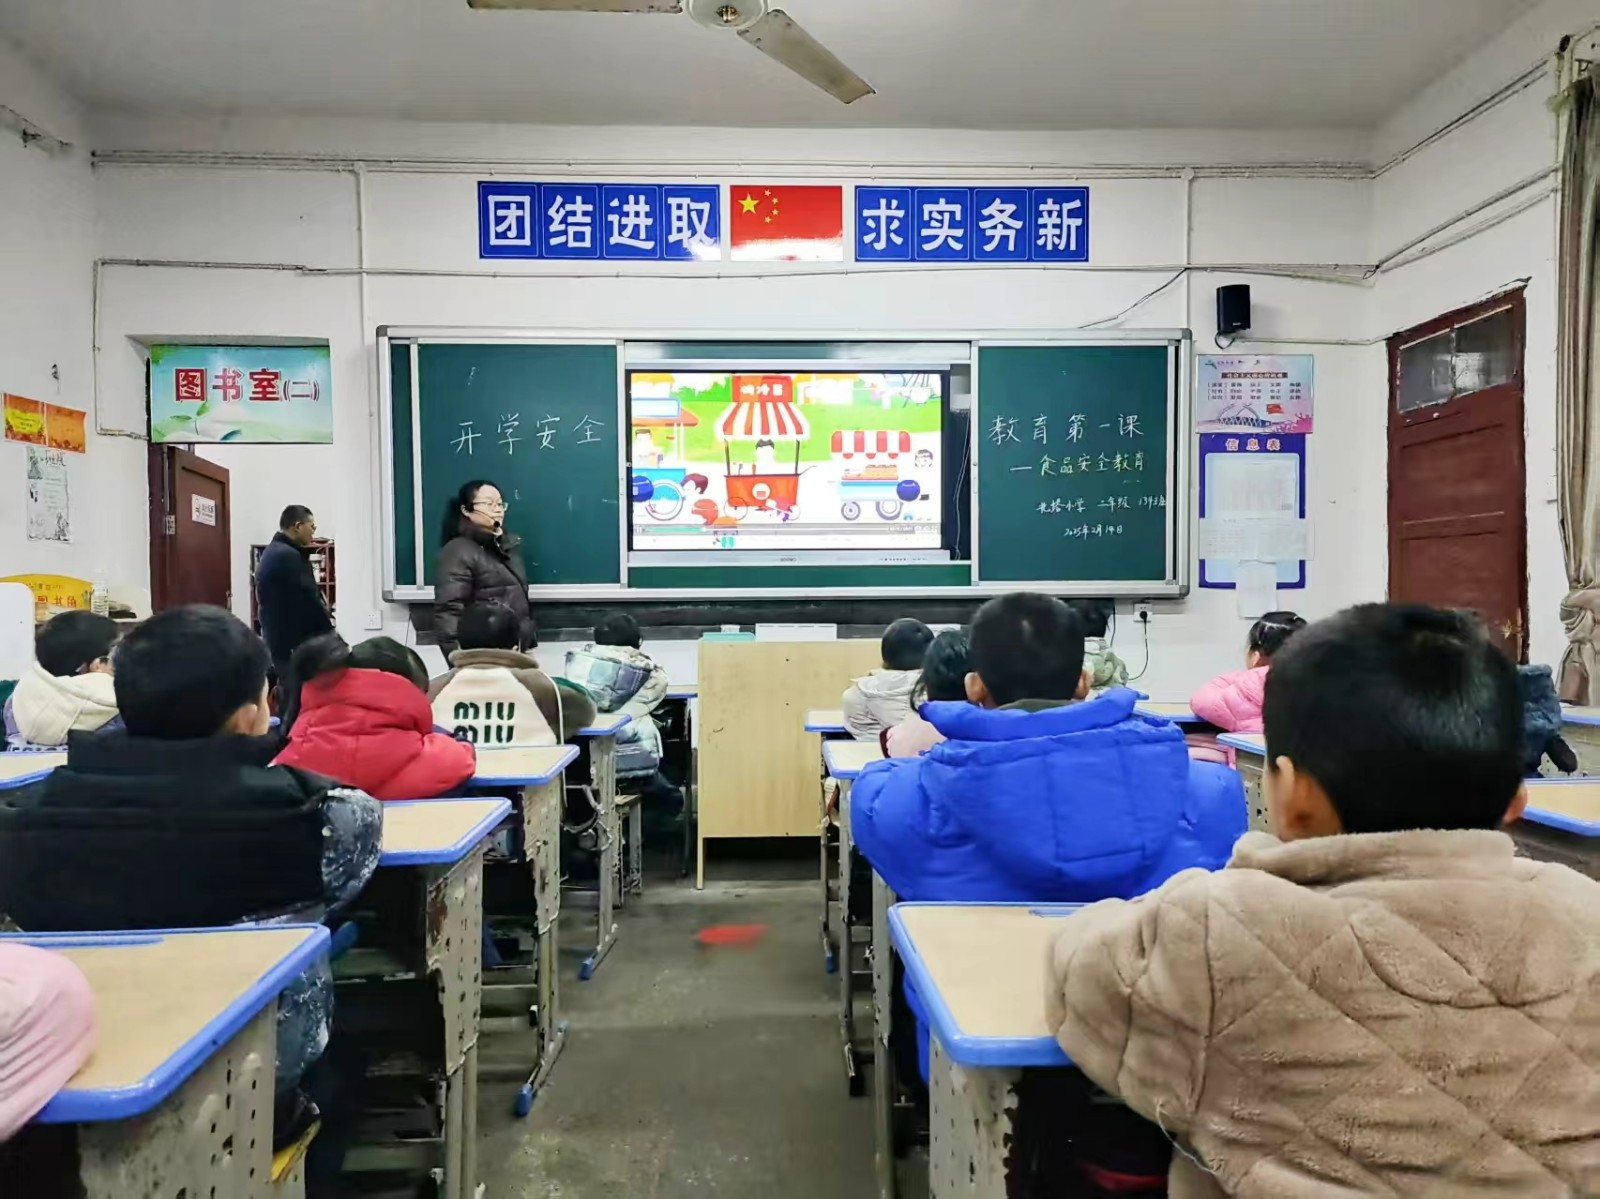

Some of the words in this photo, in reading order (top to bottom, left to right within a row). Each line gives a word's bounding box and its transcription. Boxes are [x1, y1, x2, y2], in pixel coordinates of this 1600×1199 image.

[488, 195, 716, 249] 团结进取
[862, 198, 1083, 252] 求实务新
[450, 412, 605, 455] 开学安全
[987, 413, 1144, 446] 教育第一课
[1225, 438, 1281, 452] 信息表
[1096, 496, 1131, 512] 二年级
